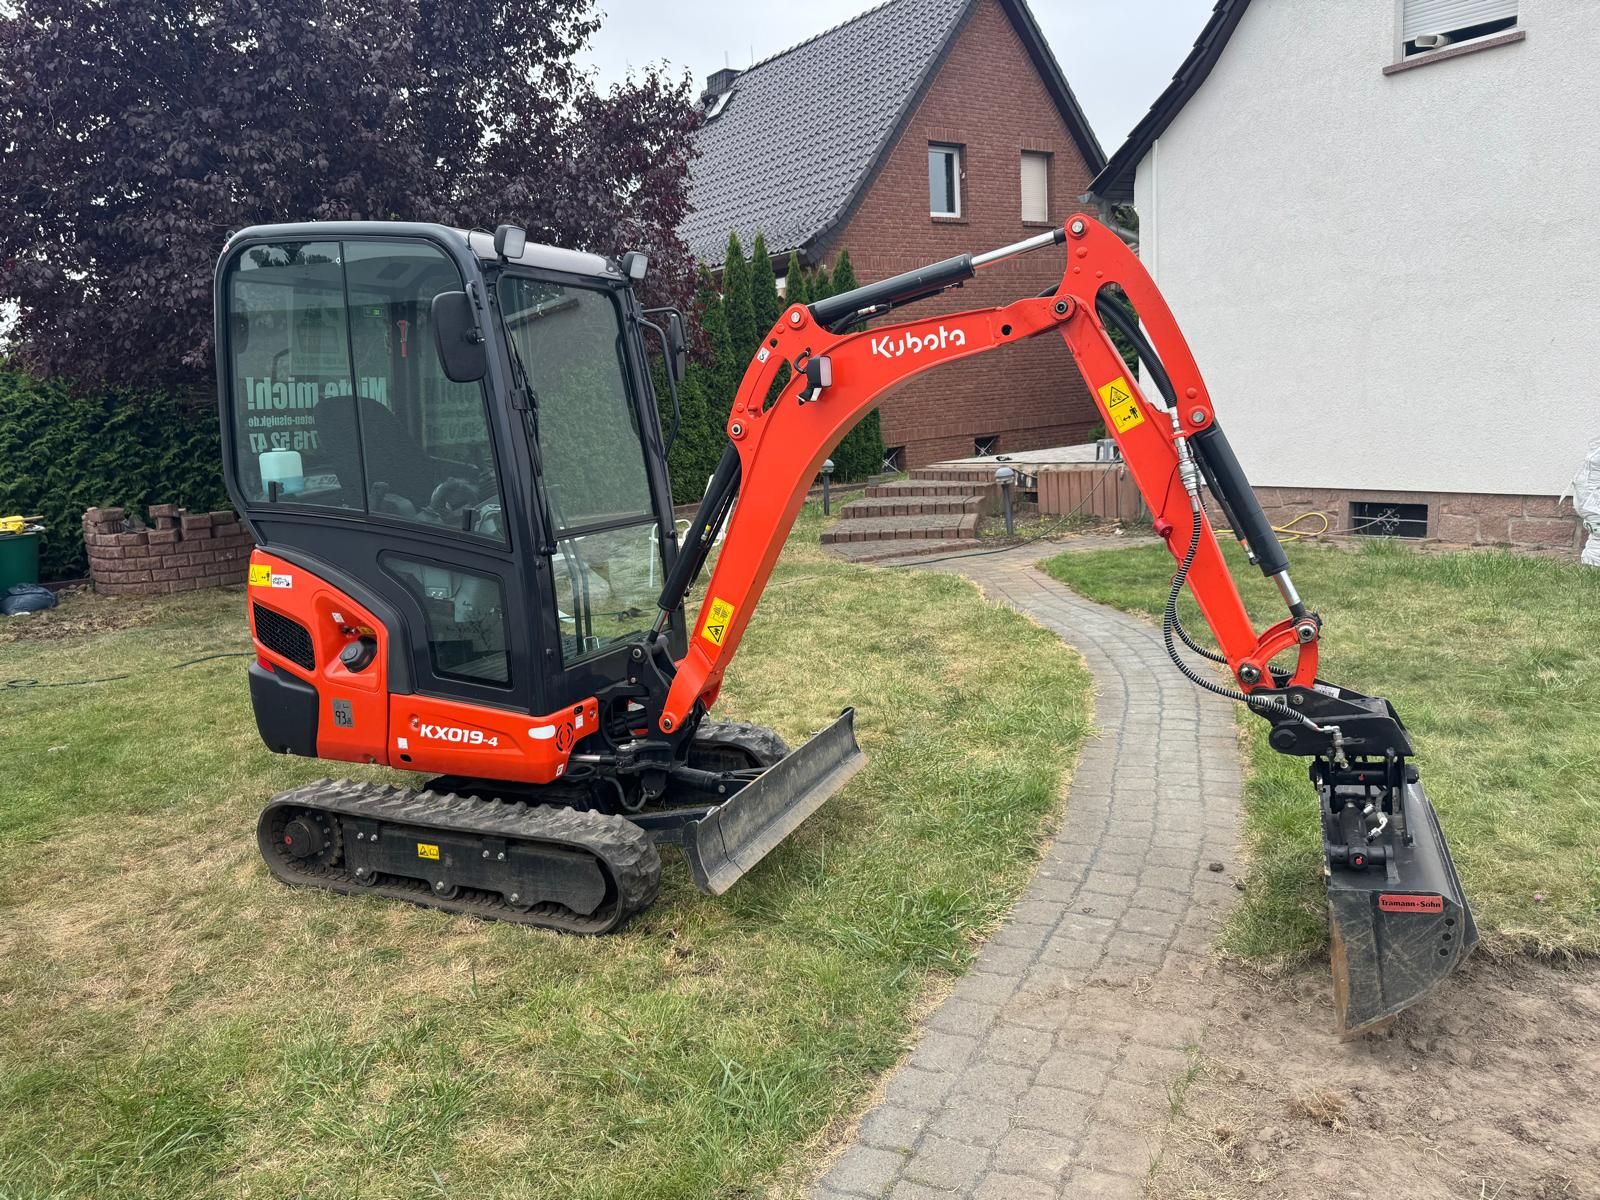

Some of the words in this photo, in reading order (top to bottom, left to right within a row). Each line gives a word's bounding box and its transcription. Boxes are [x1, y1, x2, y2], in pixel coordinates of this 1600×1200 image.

[871, 325, 966, 358] Kubota
[335, 710, 347, 725] 93
[420, 724, 499, 747] KX019-4
